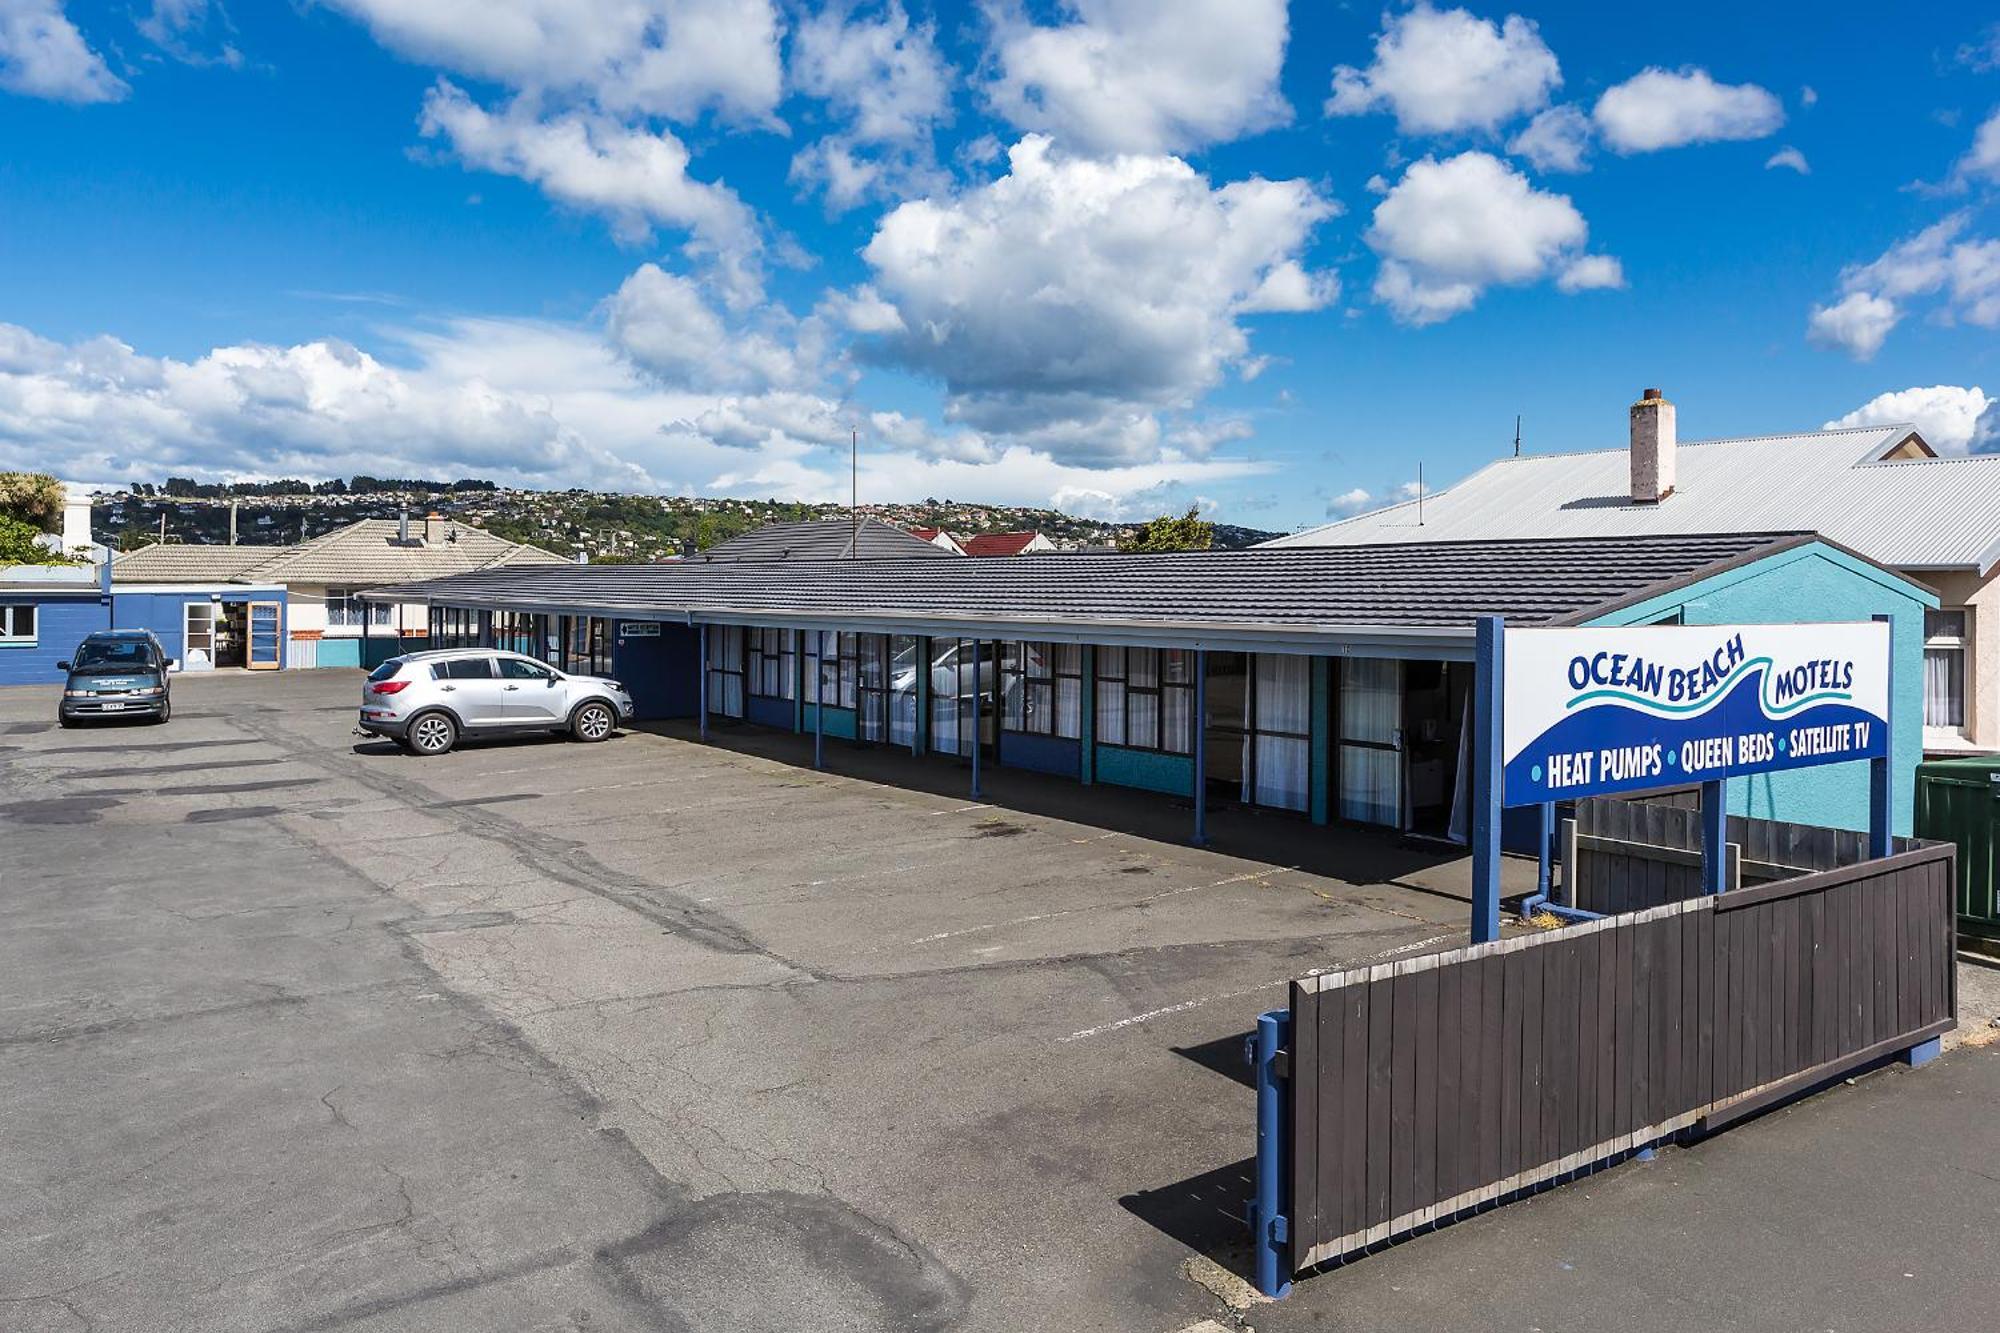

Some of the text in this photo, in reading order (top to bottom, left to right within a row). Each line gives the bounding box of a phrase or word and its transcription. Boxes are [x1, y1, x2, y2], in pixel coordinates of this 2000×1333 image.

[1568, 633, 1853, 704] OCEAN BEACH MOTELS
[1548, 722, 1870, 788] HEAT PUMPS QUEEN BEDS SATELLITE TV
